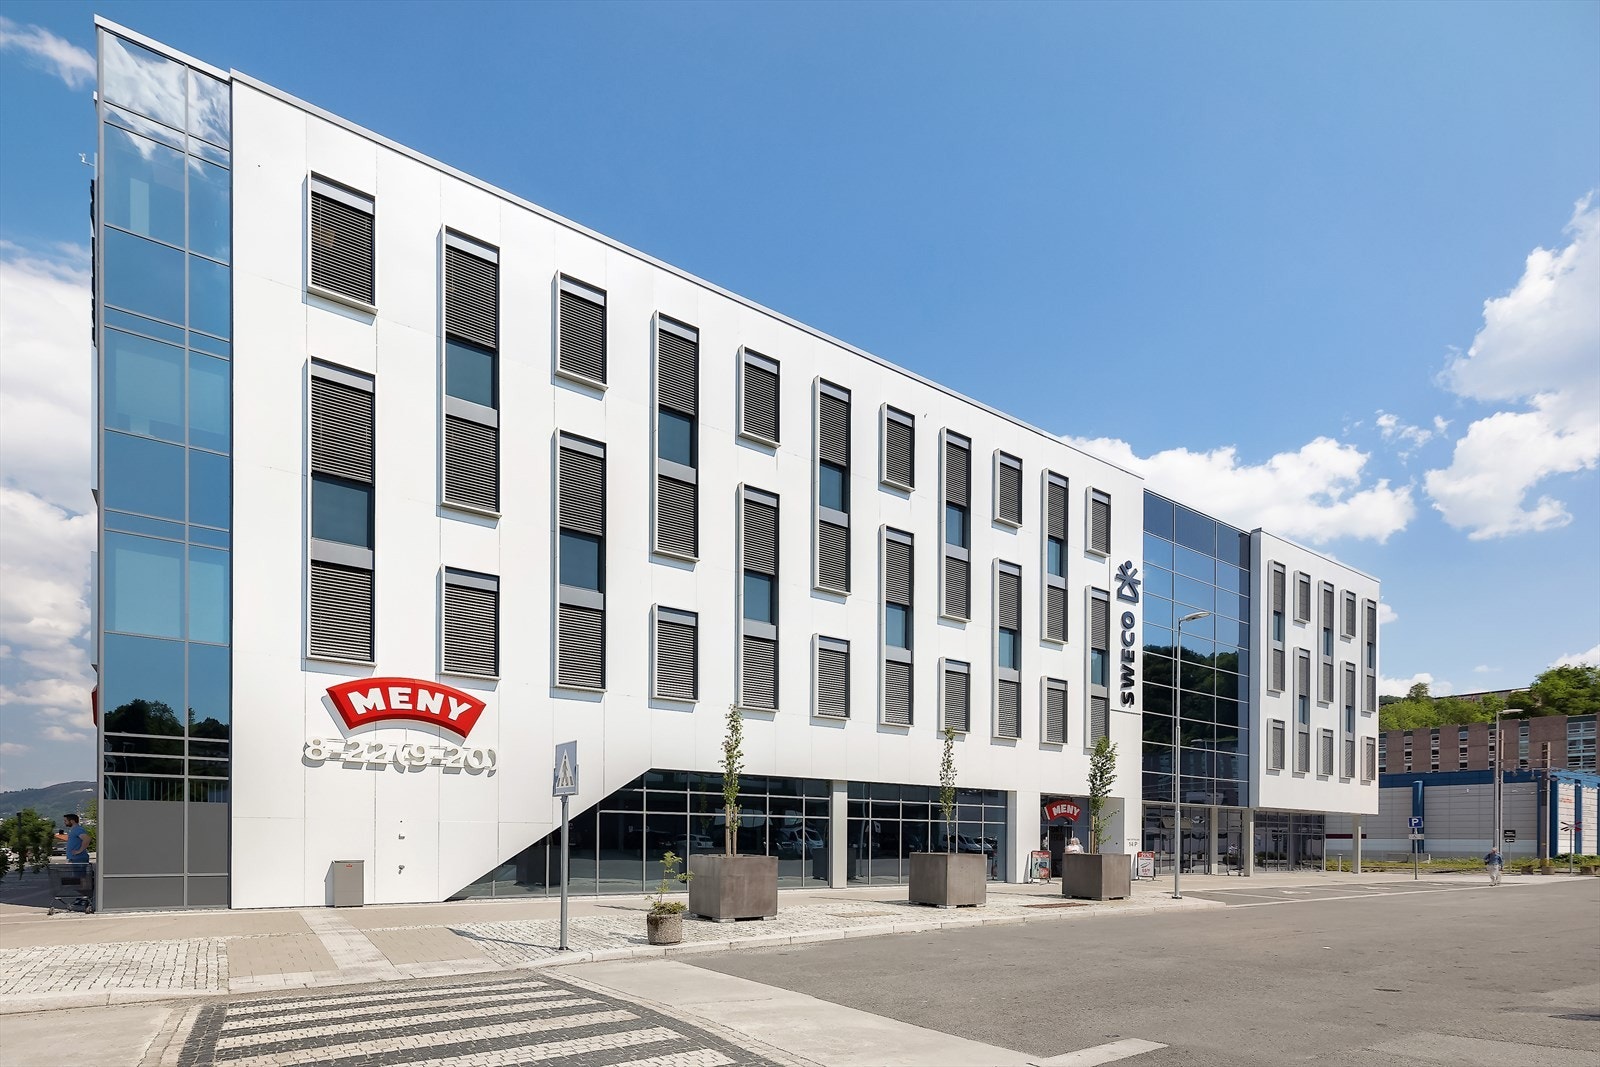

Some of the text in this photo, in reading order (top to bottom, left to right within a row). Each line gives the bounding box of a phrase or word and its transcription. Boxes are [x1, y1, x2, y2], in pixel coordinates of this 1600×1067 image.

[1120, 611, 1136, 707] SWECO
[347, 686, 473, 721] MENY
[1052, 804, 1080, 816] MENY
